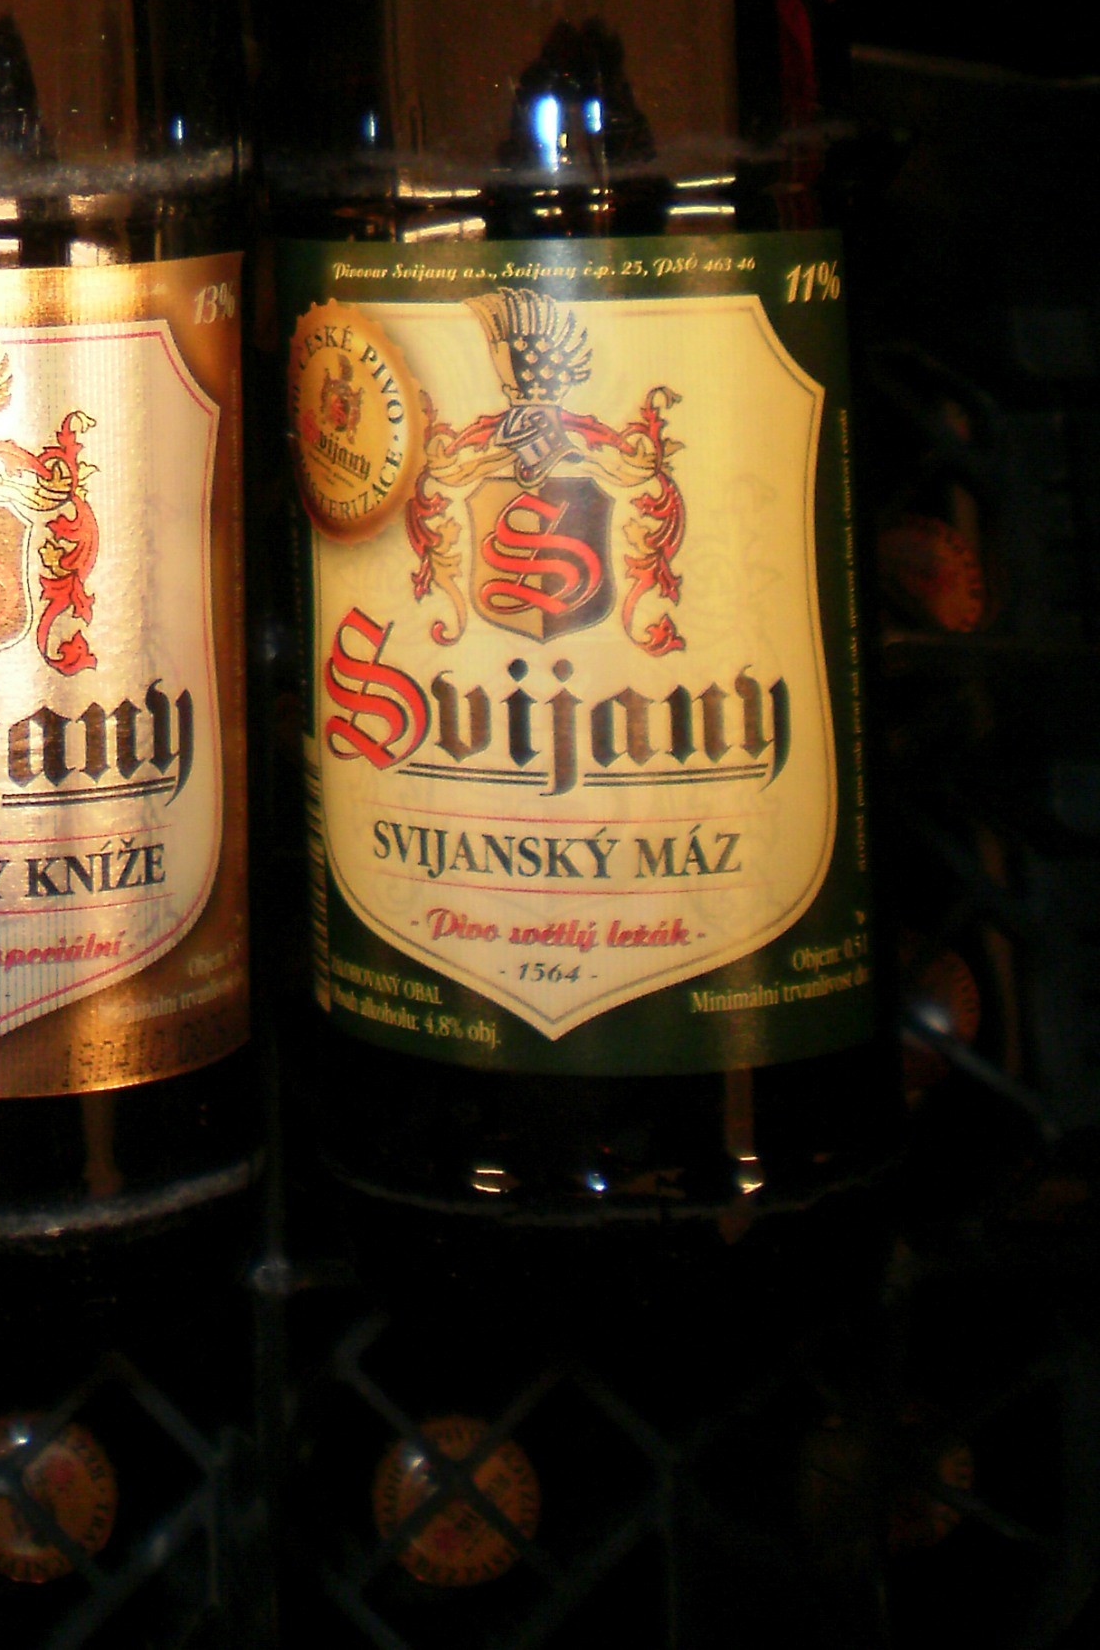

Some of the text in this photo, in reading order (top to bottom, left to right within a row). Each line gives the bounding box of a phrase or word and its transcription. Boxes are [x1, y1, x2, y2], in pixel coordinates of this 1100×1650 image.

[332, 261, 388, 281] Pivovar
[391, 262, 458, 283] Svijany
[500, 261, 578, 282] Svijany
[620, 259, 650, 278] 25,
[652, 252, 699, 278] PSČ
[702, 256, 733, 273] 463
[735, 256, 757, 271] 46
[785, 259, 842, 304] 11%
[192, 279, 237, 327] 13%
[359, 341, 405, 427] PIVO
[323, 606, 792, 798] Svijany
[24, 836, 168, 900] KNÍŽE
[371, 819, 744, 881] SVIJANSKÝ MÁZ
[425, 906, 692, 952] Pivo světlý ležák
[402, 979, 444, 1006] OBAL
[516, 960, 582, 985] 1564
[689, 980, 781, 1015] Minimální
[466, 1020, 502, 1051] obj.
